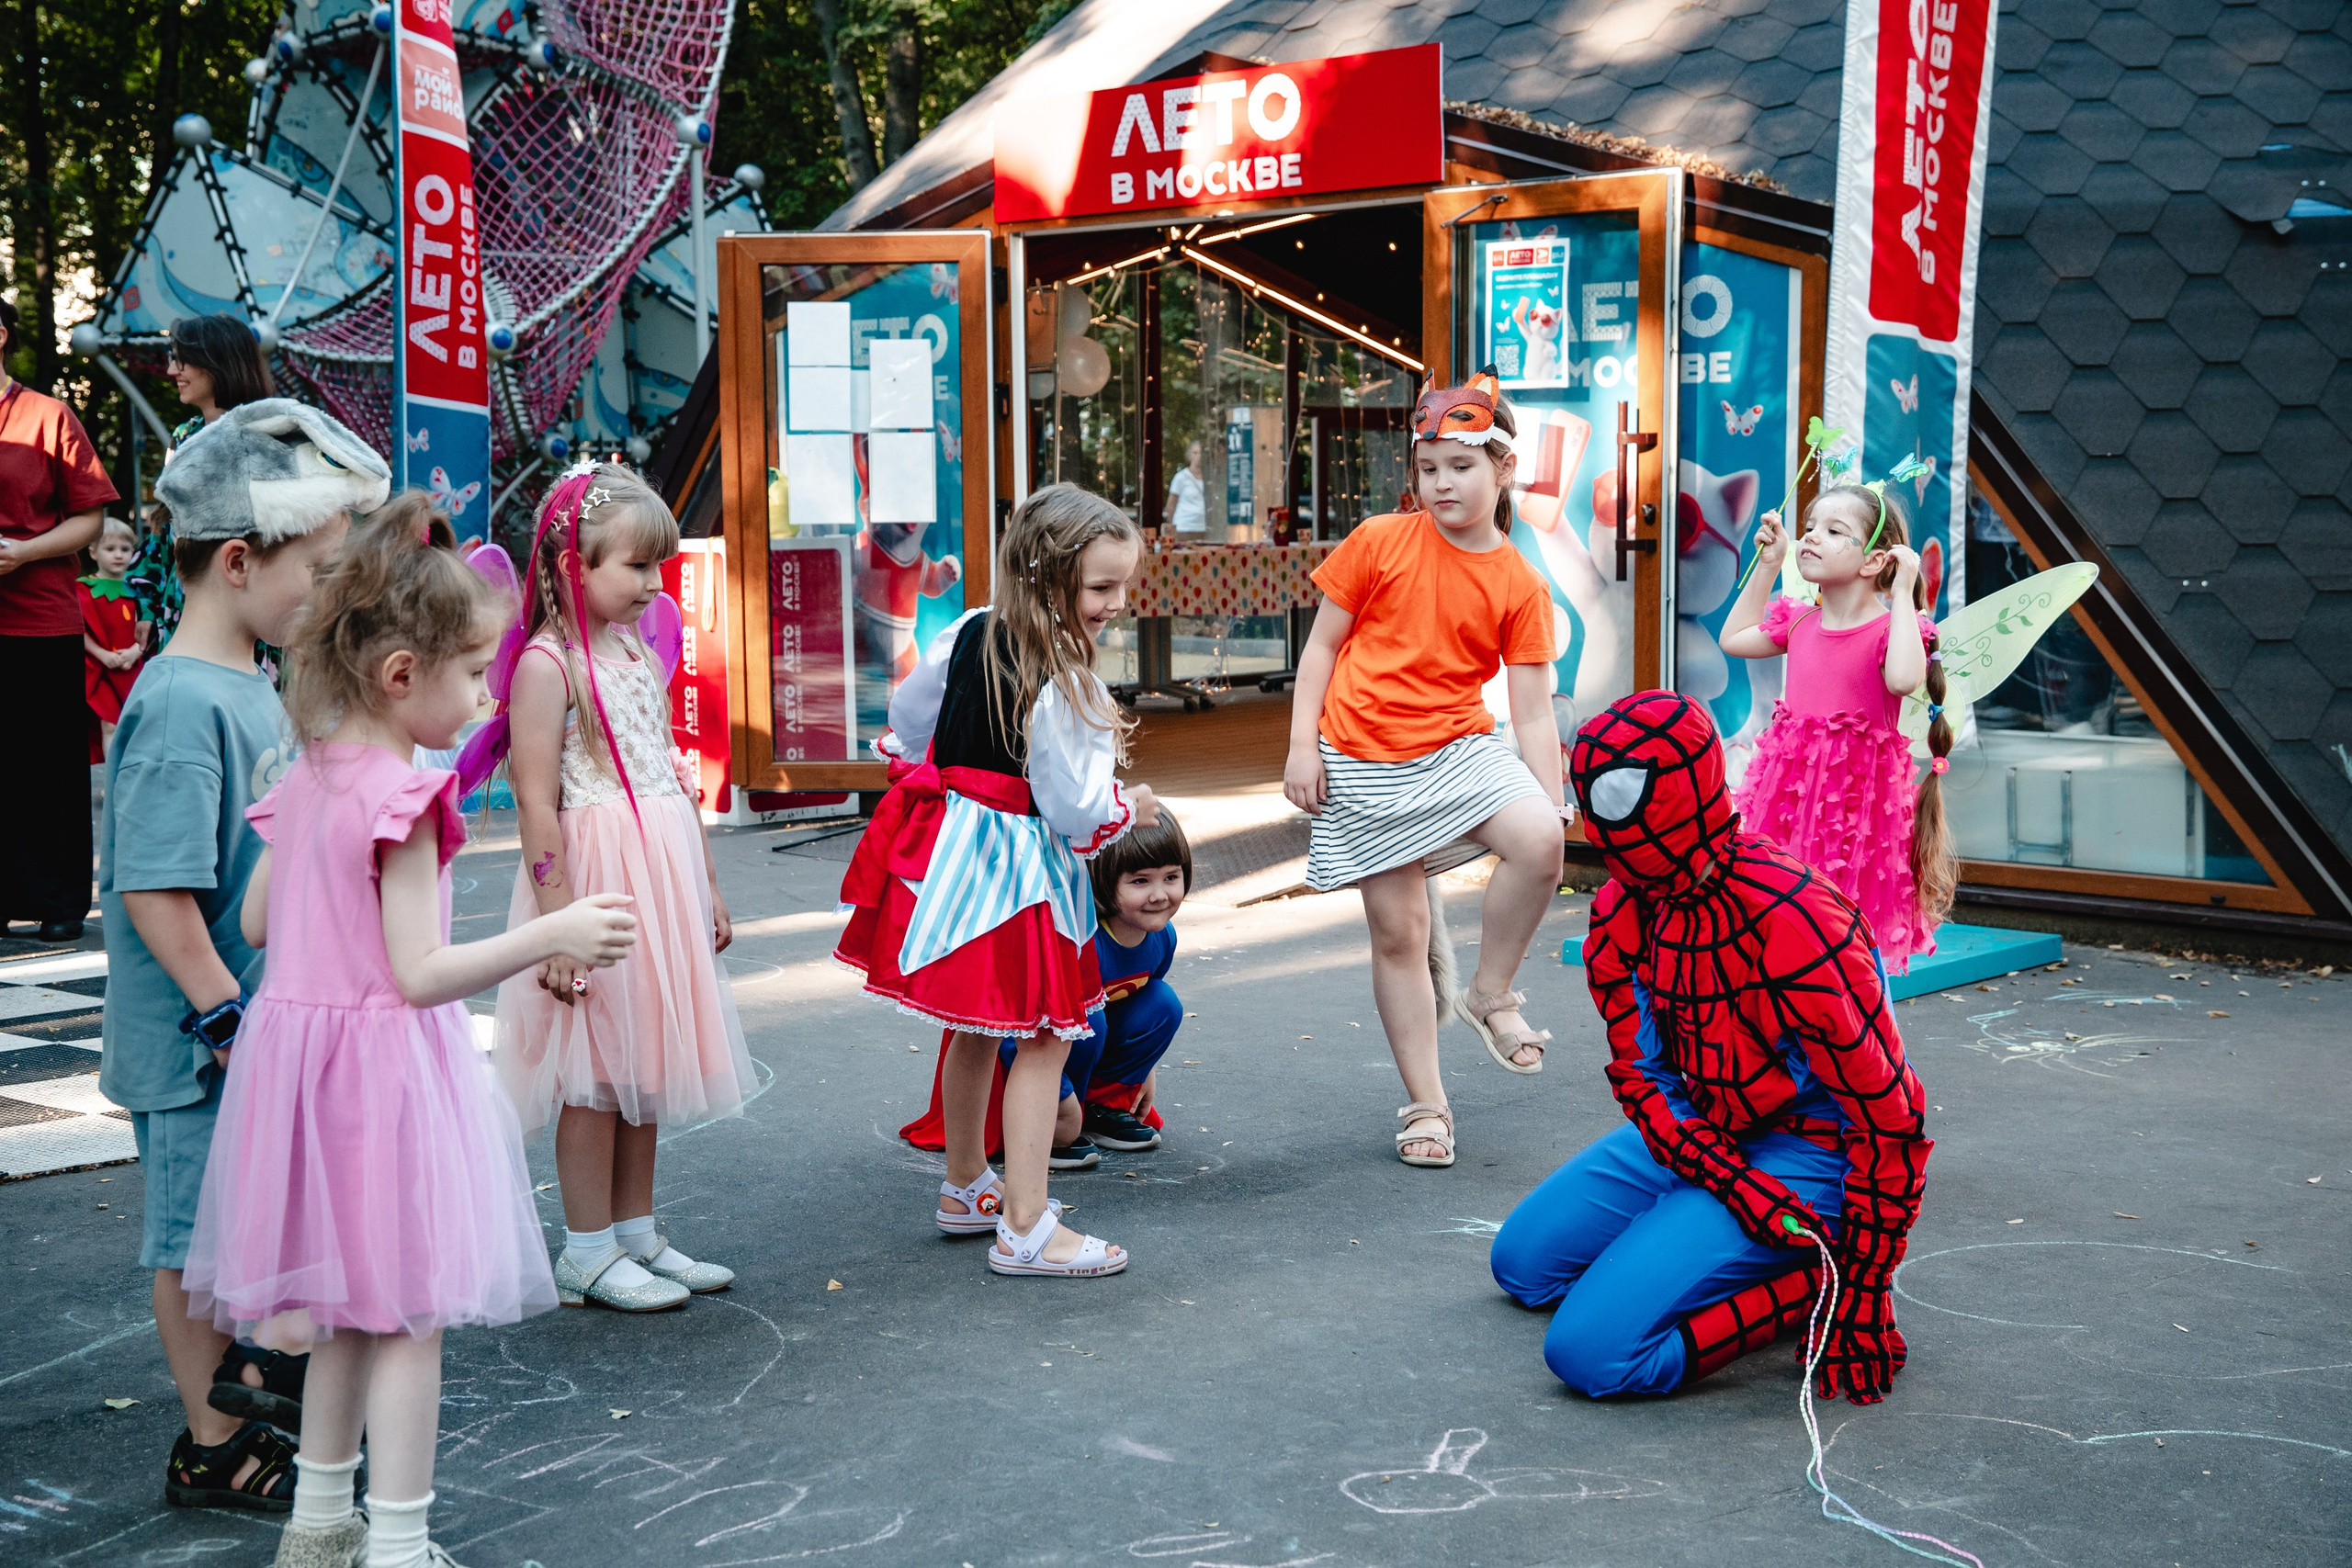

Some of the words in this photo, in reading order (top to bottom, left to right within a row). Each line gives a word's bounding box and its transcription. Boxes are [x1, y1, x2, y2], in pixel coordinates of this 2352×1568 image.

[1111, 73, 1301, 157] ЛЕТО
[1922, 0, 1959, 231] МОСКВЕ
[1111, 172, 1135, 205] В
[1146, 152, 1303, 201] МОСКВЕ
[409, 175, 455, 364] ЛЕТО
[459, 184, 478, 334] МОСКВЕ
[1921, 248, 1936, 286] В
[458, 345, 478, 369] В
[851, 313, 949, 367] ЕТО
[782, 561, 794, 611] ЛЕТО
[783, 624, 795, 673] ЛЕТО
[684, 685, 694, 736] ЛЕТО
[785, 684, 797, 734] ЛЕТО
